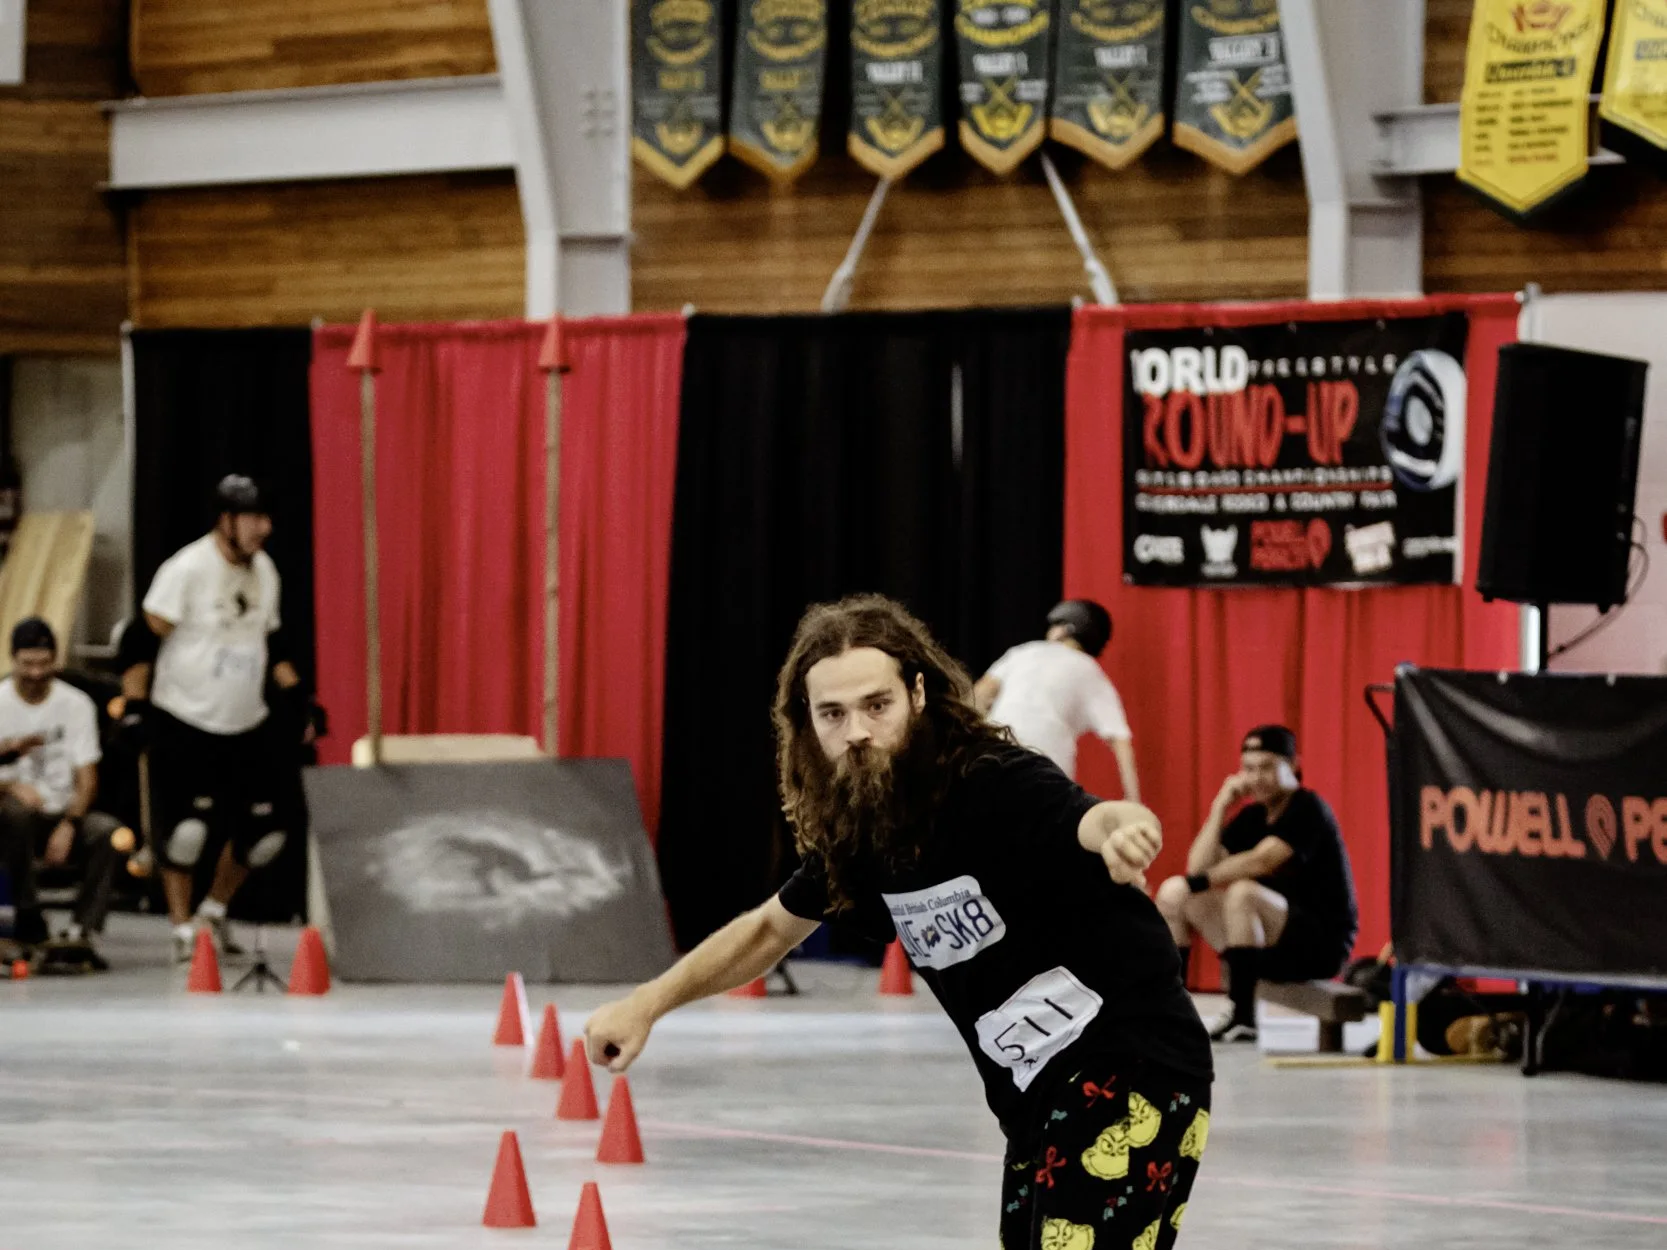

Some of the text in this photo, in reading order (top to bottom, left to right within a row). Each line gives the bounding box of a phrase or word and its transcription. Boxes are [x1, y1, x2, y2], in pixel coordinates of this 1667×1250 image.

[1142, 379, 1359, 469] ROUND-UP
[1420, 785, 1587, 858] POWELL
[927, 888, 972, 911] Columbia
[934, 898, 995, 950] SK8
[993, 997, 1074, 1062] 511
